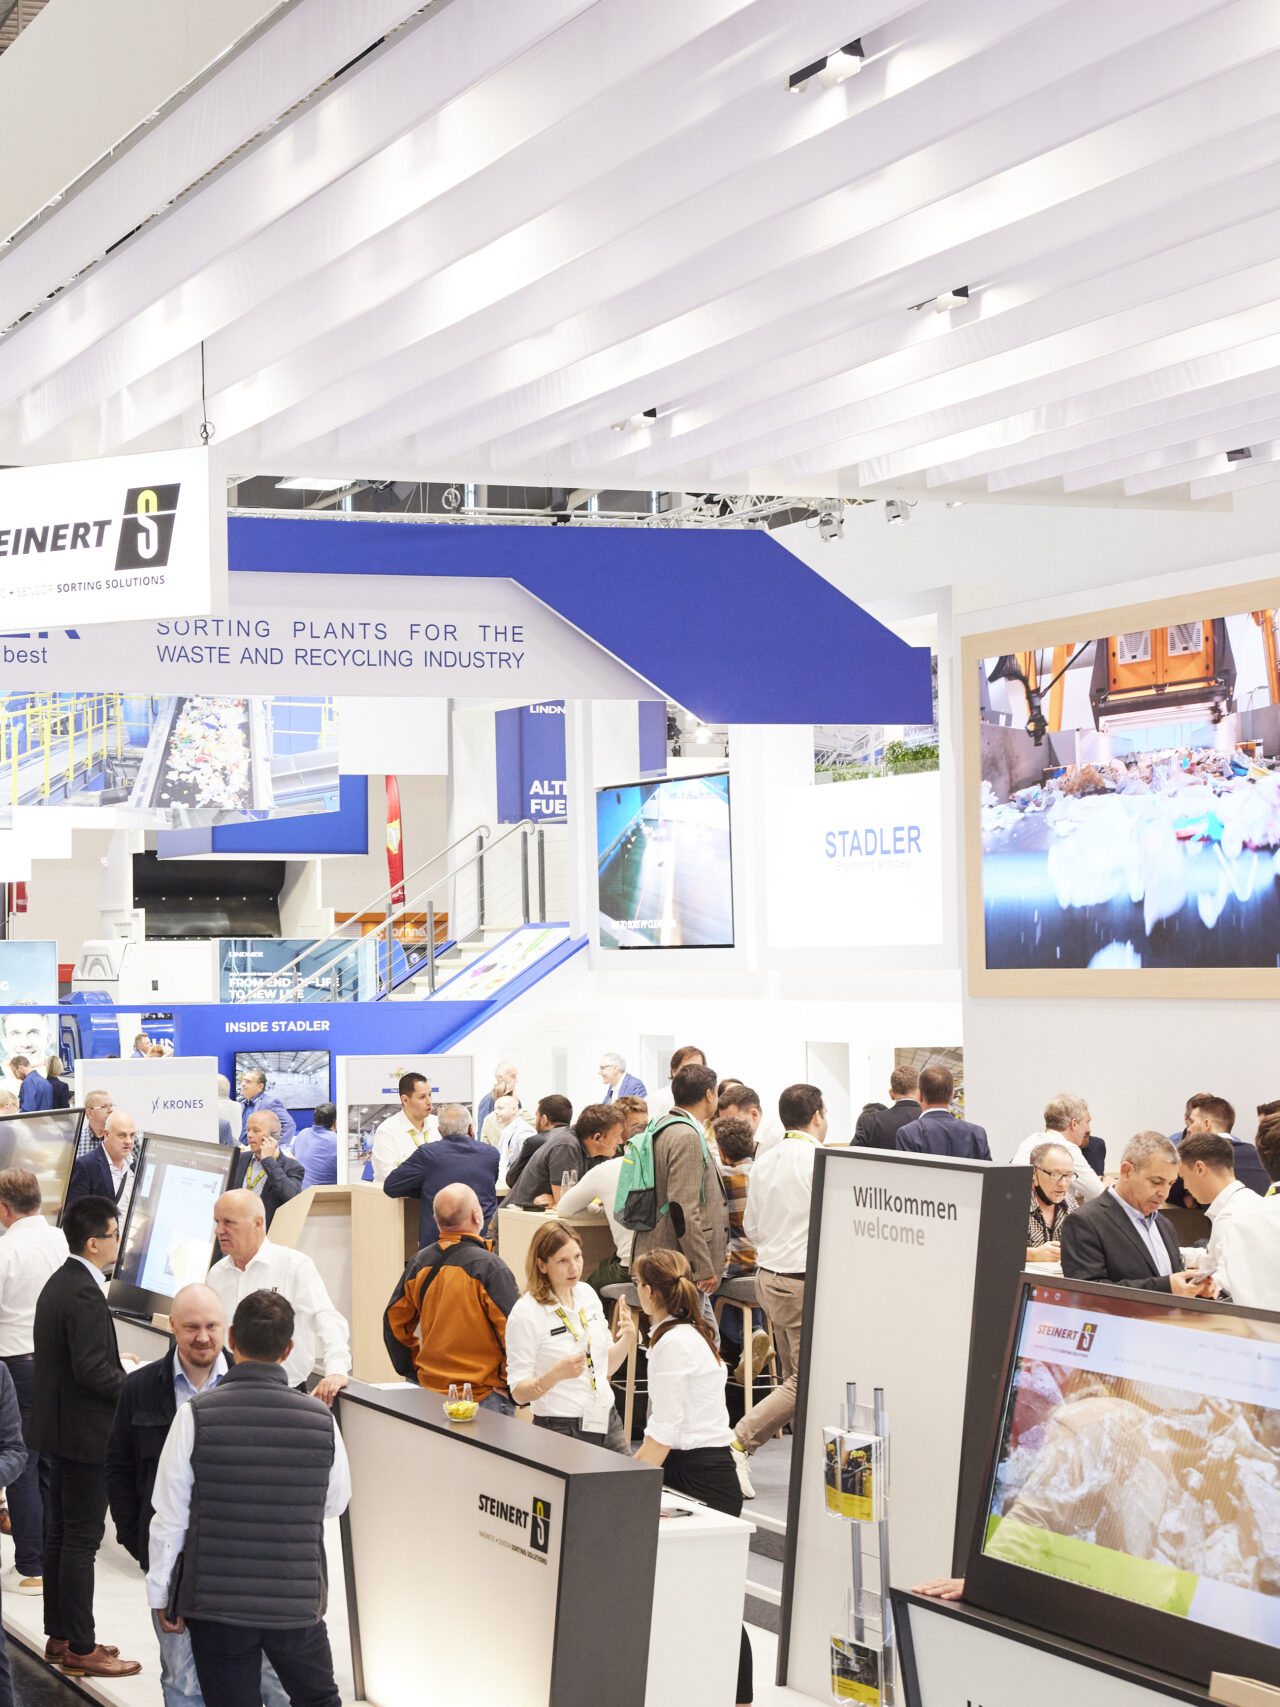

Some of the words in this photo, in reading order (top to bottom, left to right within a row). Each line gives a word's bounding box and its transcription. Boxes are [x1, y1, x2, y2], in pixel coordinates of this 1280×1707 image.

[57, 581, 102, 593] SORTING
[106, 575, 165, 590] SOLUTIONS
[157, 619, 270, 637] SORTING
[293, 621, 388, 640] PLANTS
[410, 623, 458, 642] FOR
[479, 625, 524, 642] THE
[4, 645, 48, 663] best
[156, 645, 230, 664] WASTE
[240, 647, 283, 665] AND
[295, 648, 413, 667] RECYCLING
[424, 651, 524, 669] INDUSTRY
[529, 704, 565, 714] LINDN
[825, 825, 922, 858] STADLER
[229, 978, 262, 988] FROM
[229, 989, 246, 999] TO
[225, 1022, 268, 1033] INSIDE
[271, 1021, 330, 1032] STADLER
[163, 1099, 204, 1109] KRONES
[853, 1186, 957, 1221] Willkommen
[853, 1217, 925, 1246] welcome
[1037, 1324, 1079, 1341] STEINERT
[478, 1494, 529, 1529] STEINERT
